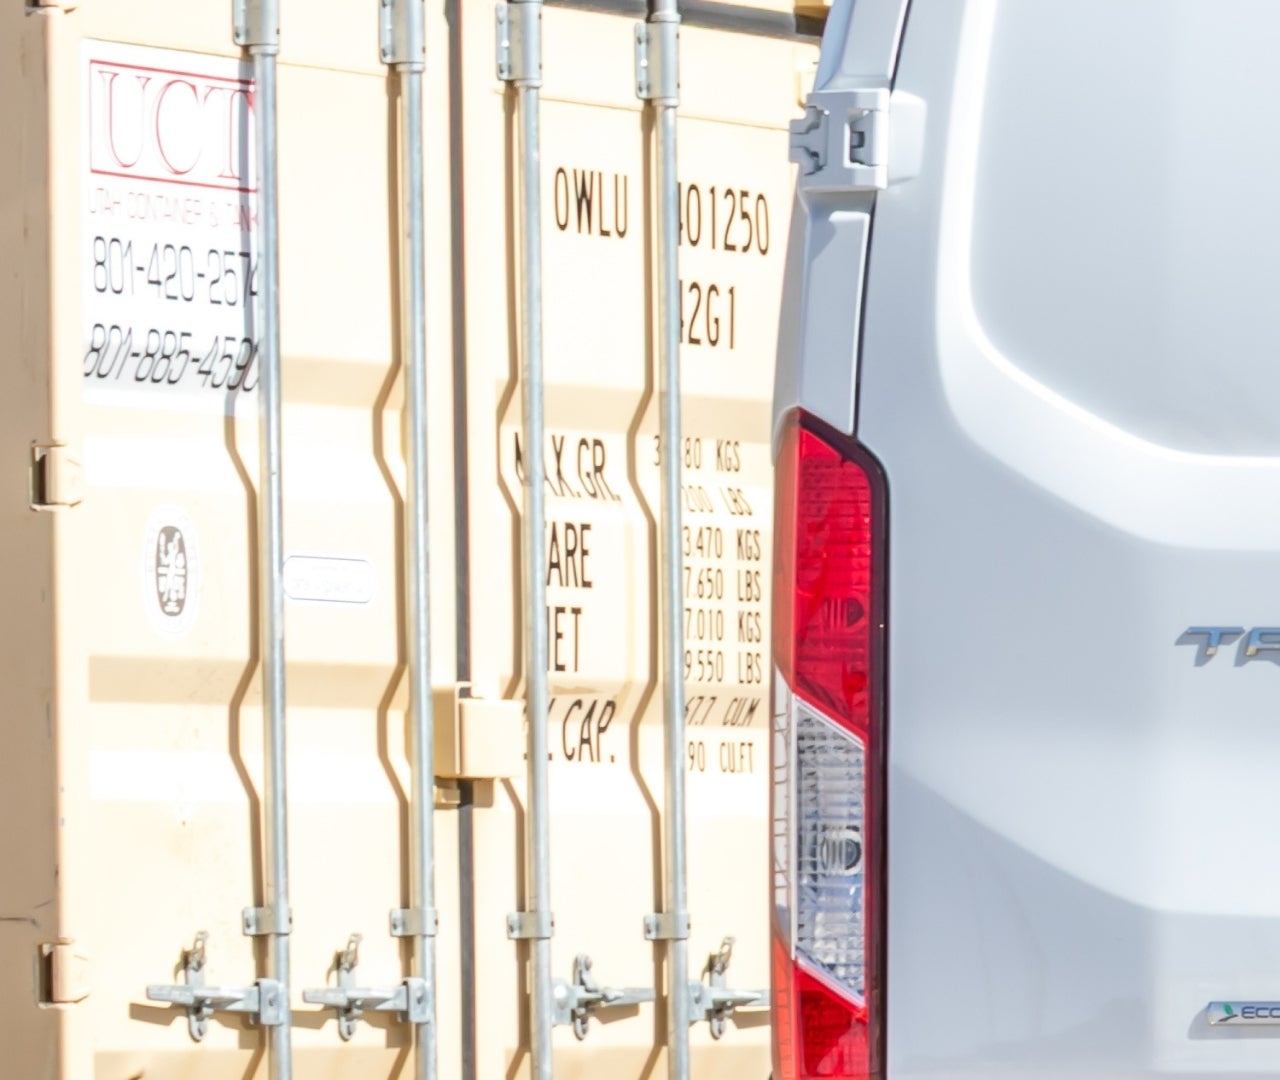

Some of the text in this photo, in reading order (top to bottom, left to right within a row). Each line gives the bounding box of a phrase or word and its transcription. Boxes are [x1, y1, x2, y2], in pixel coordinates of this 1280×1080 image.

[554, 166, 628, 239] OWLU
[716, 438, 740, 473] KGS
[544, 521, 593, 588] ARE
[737, 528, 761, 562] KGS
[737, 569, 761, 602] LBS
[546, 605, 762, 673] ET 7.010 KGS
[684, 650, 762, 684] 9.550 LBS
